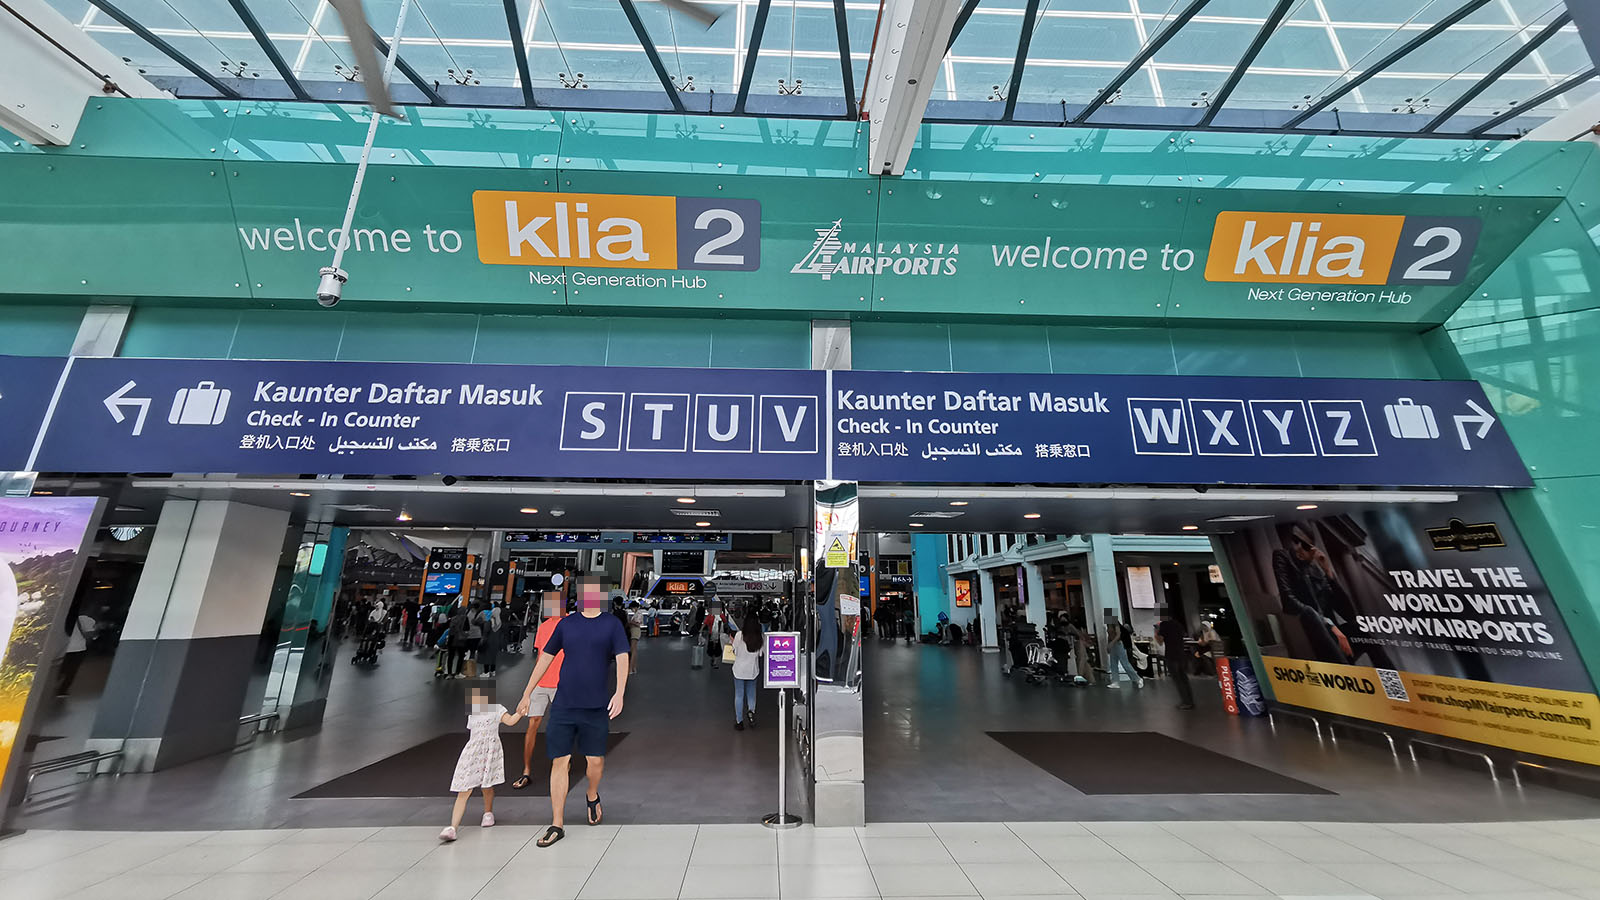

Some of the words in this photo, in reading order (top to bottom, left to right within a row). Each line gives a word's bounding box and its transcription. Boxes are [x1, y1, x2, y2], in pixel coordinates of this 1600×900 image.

[238, 218, 411, 252] welcome
[422, 224, 462, 253] to
[504, 200, 650, 261] klia
[694, 208, 746, 265] 2
[843, 242, 960, 254] MALAYSIA
[991, 236, 1148, 270] welcome
[1160, 244, 1194, 271] to
[1233, 220, 1364, 279] klia
[1402, 226, 1461, 281] 2
[832, 256, 958, 275] AIRPORTS
[529, 271, 567, 286] Next
[571, 272, 666, 288] Generation
[671, 275, 707, 289] Hub
[1247, 287, 1284, 301] Next
[1288, 288, 1374, 303] Generation
[1378, 290, 1411, 304] Hub
[253, 381, 361, 403] Kaunter
[368, 382, 452, 405] Daftar
[459, 384, 543, 406] Masuk
[837, 390, 939, 412] Kaunter
[944, 391, 1022, 413] Daftar
[1029, 391, 1110, 414] Masuk
[246, 410, 303, 427] Check
[320, 411, 338, 428] In
[344, 411, 420, 429] Counter
[580, 401, 607, 441] S
[644, 403, 674, 440] T
[708, 404, 740, 442] U
[774, 405, 807, 442] V
[837, 418, 890, 435] Check
[906, 418, 924, 435] In
[928, 418, 999, 436] Counter
[1133, 407, 1182, 445] W
[1202, 409, 1240, 446] X
[1262, 409, 1294, 446] Y
[1326, 410, 1360, 447] Z
[239, 434, 315, 450] 登机入口处
[328, 436, 393, 455] التسجيل
[398, 437, 438, 451] مكتب
[837, 442, 909, 458] 登机入口处
[921, 443, 980, 460] التسجيل
[985, 444, 1022, 457] مكتب
[688, 582, 696, 591] 2
[1389, 568, 1473, 589] TRAVEL
[1471, 567, 1528, 589] THE
[1383, 592, 1464, 615] WORLD
[1463, 593, 1542, 617] WITH
[1356, 615, 1555, 645] SHOPMYAIRPORTS
[1425, 642, 1453, 652] TRAVEL
[1455, 645, 1480, 653] WHEN
[1480, 647, 1498, 656] YOU
[1499, 648, 1524, 657] SHOP
[1526, 650, 1563, 661] ONLINE
[1221, 665, 1234, 701] PLASTIC
[1273, 666, 1305, 684] SHOP
[1319, 673, 1376, 695] WORLD
[1502, 691, 1531, 704] SPREE
[1532, 695, 1570, 709] ONLINE
[1571, 701, 1584, 709] AT
[1417, 692, 1592, 731] www.shopMYairports.com.my
